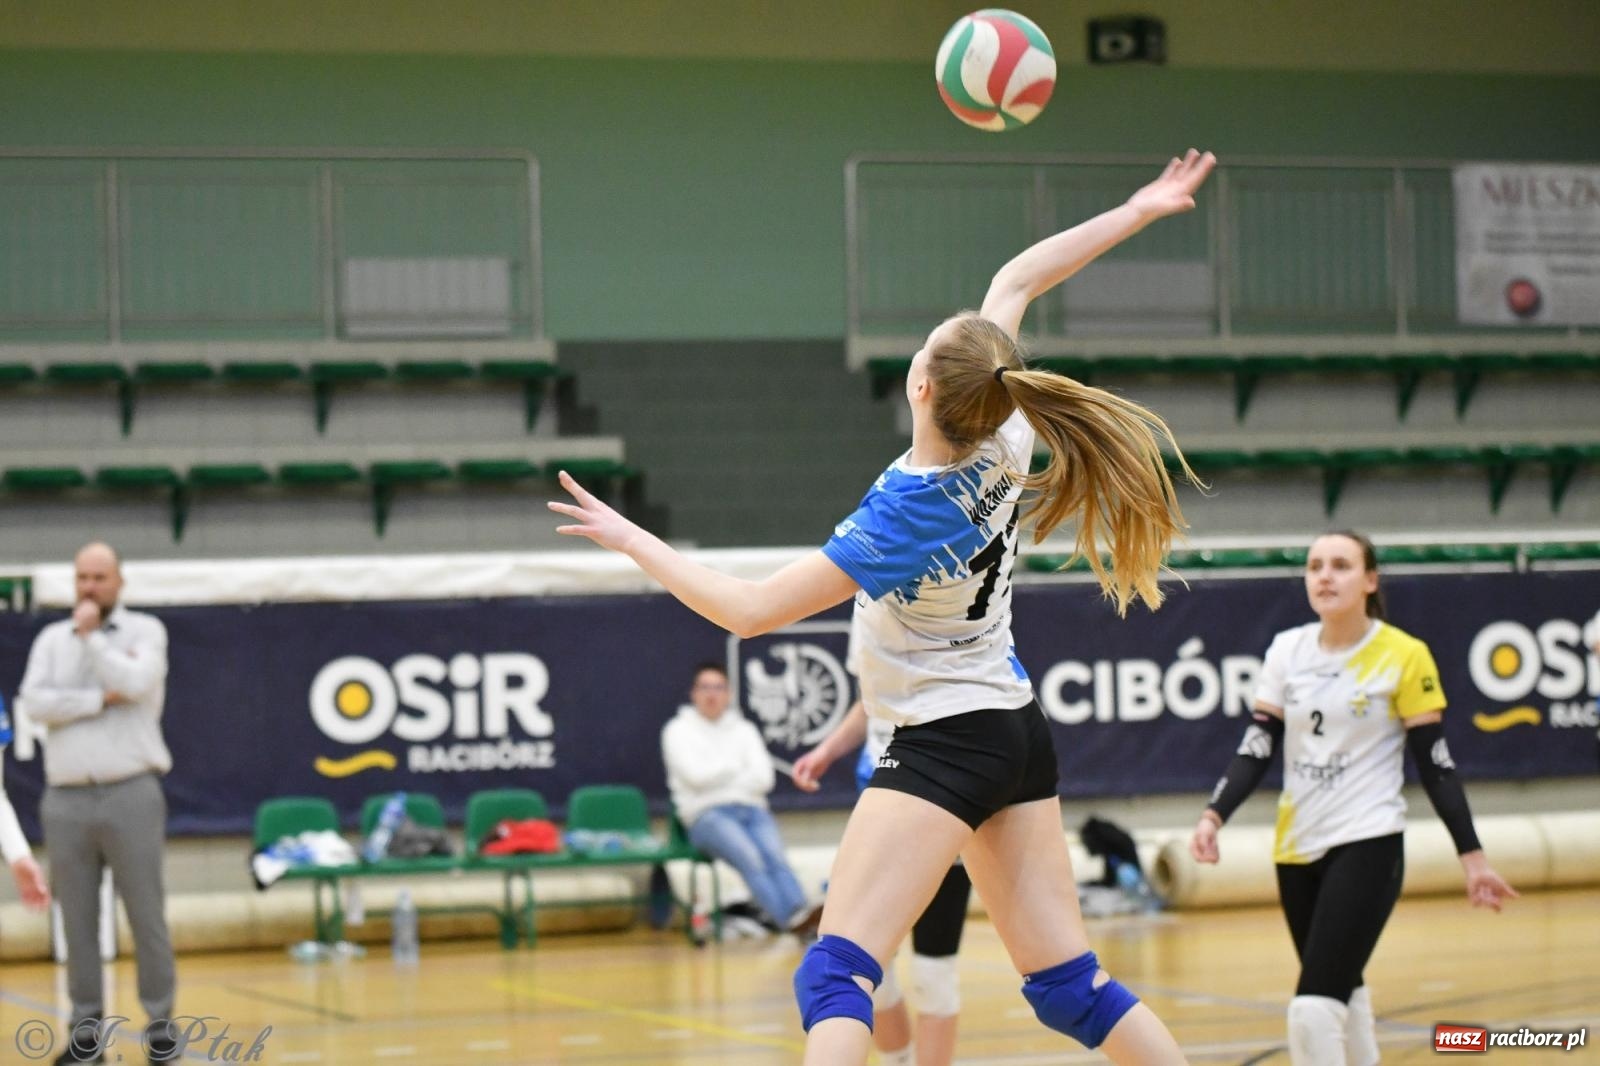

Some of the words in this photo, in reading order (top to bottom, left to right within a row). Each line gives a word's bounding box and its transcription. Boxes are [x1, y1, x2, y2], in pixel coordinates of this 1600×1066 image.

[308, 652, 555, 744] OSiR
[1310, 709, 1325, 736] 2
[407, 737, 556, 773] RACIBÓRZ
